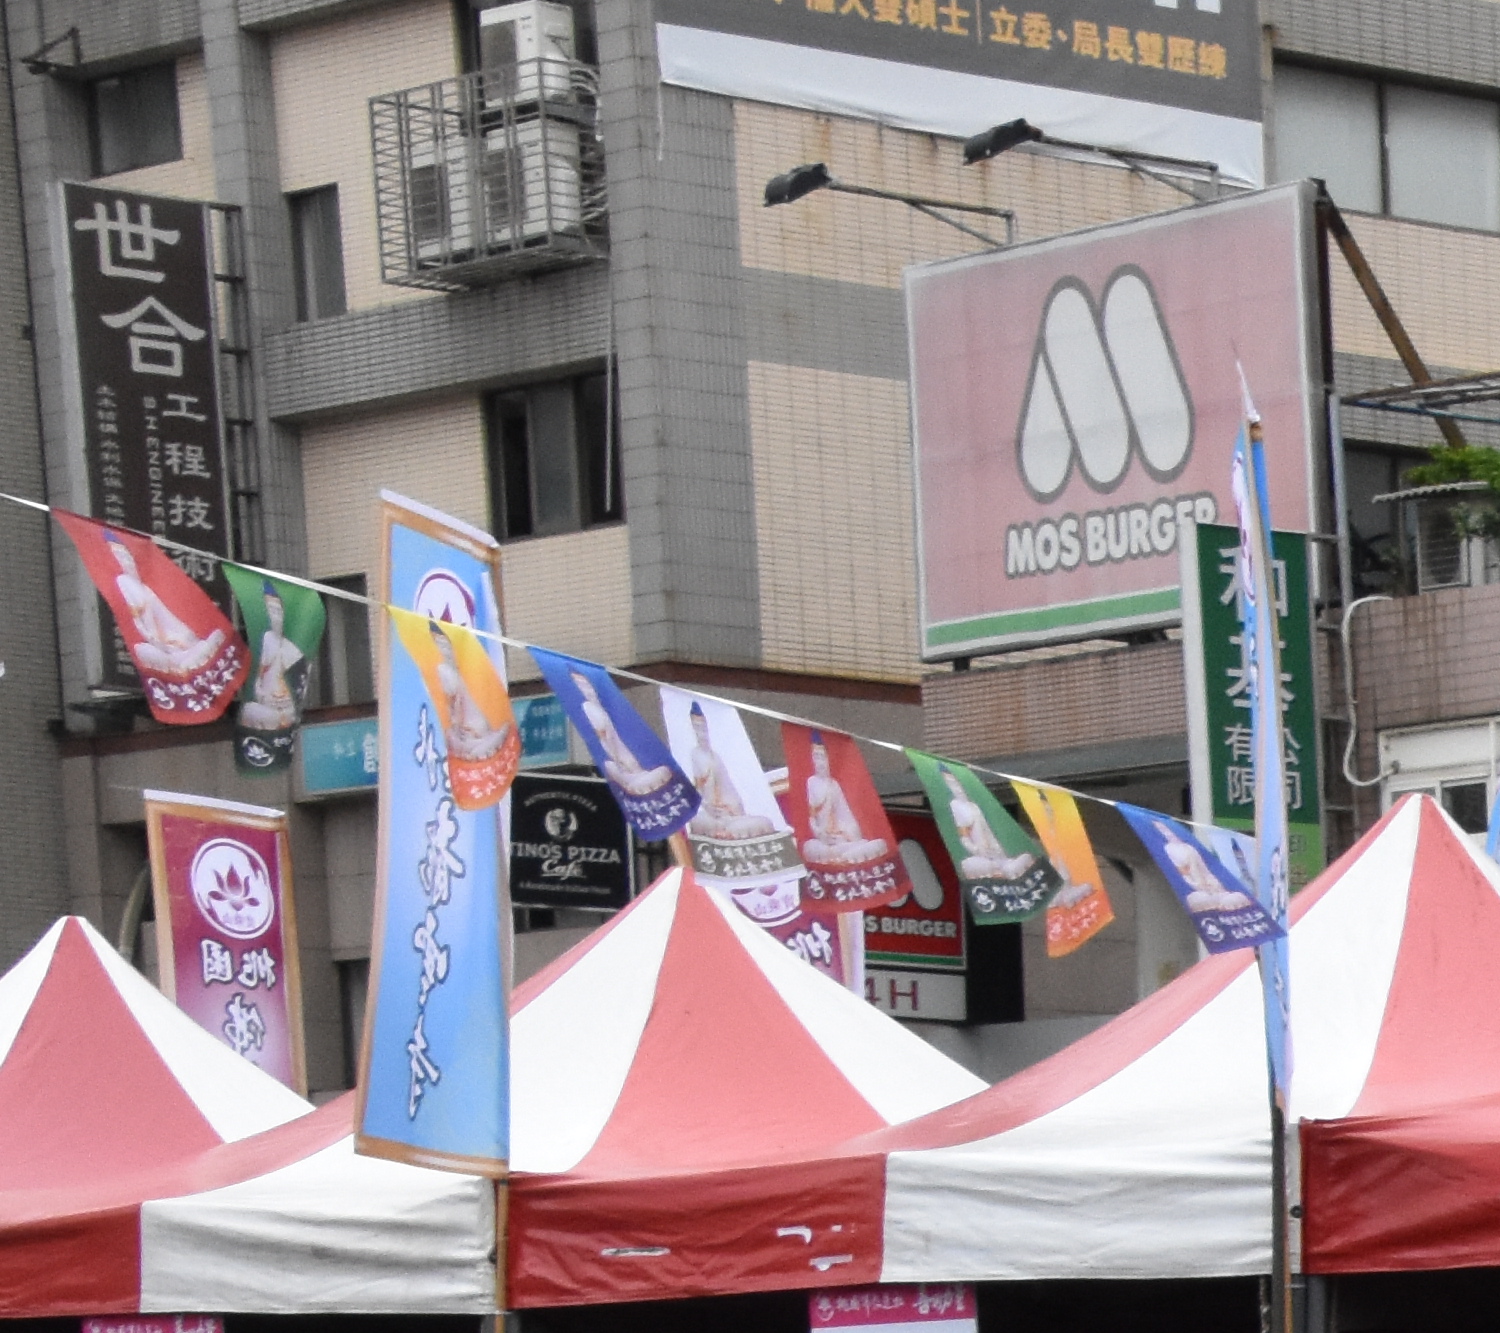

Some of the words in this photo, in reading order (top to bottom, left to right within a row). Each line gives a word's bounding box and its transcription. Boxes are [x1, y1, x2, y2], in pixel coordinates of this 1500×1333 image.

[74, 199, 207, 377] 世合
[162, 393, 218, 581] 工程技術
[1007, 526, 1082, 577] MOS
[567, 845, 621, 863] PIZZA
